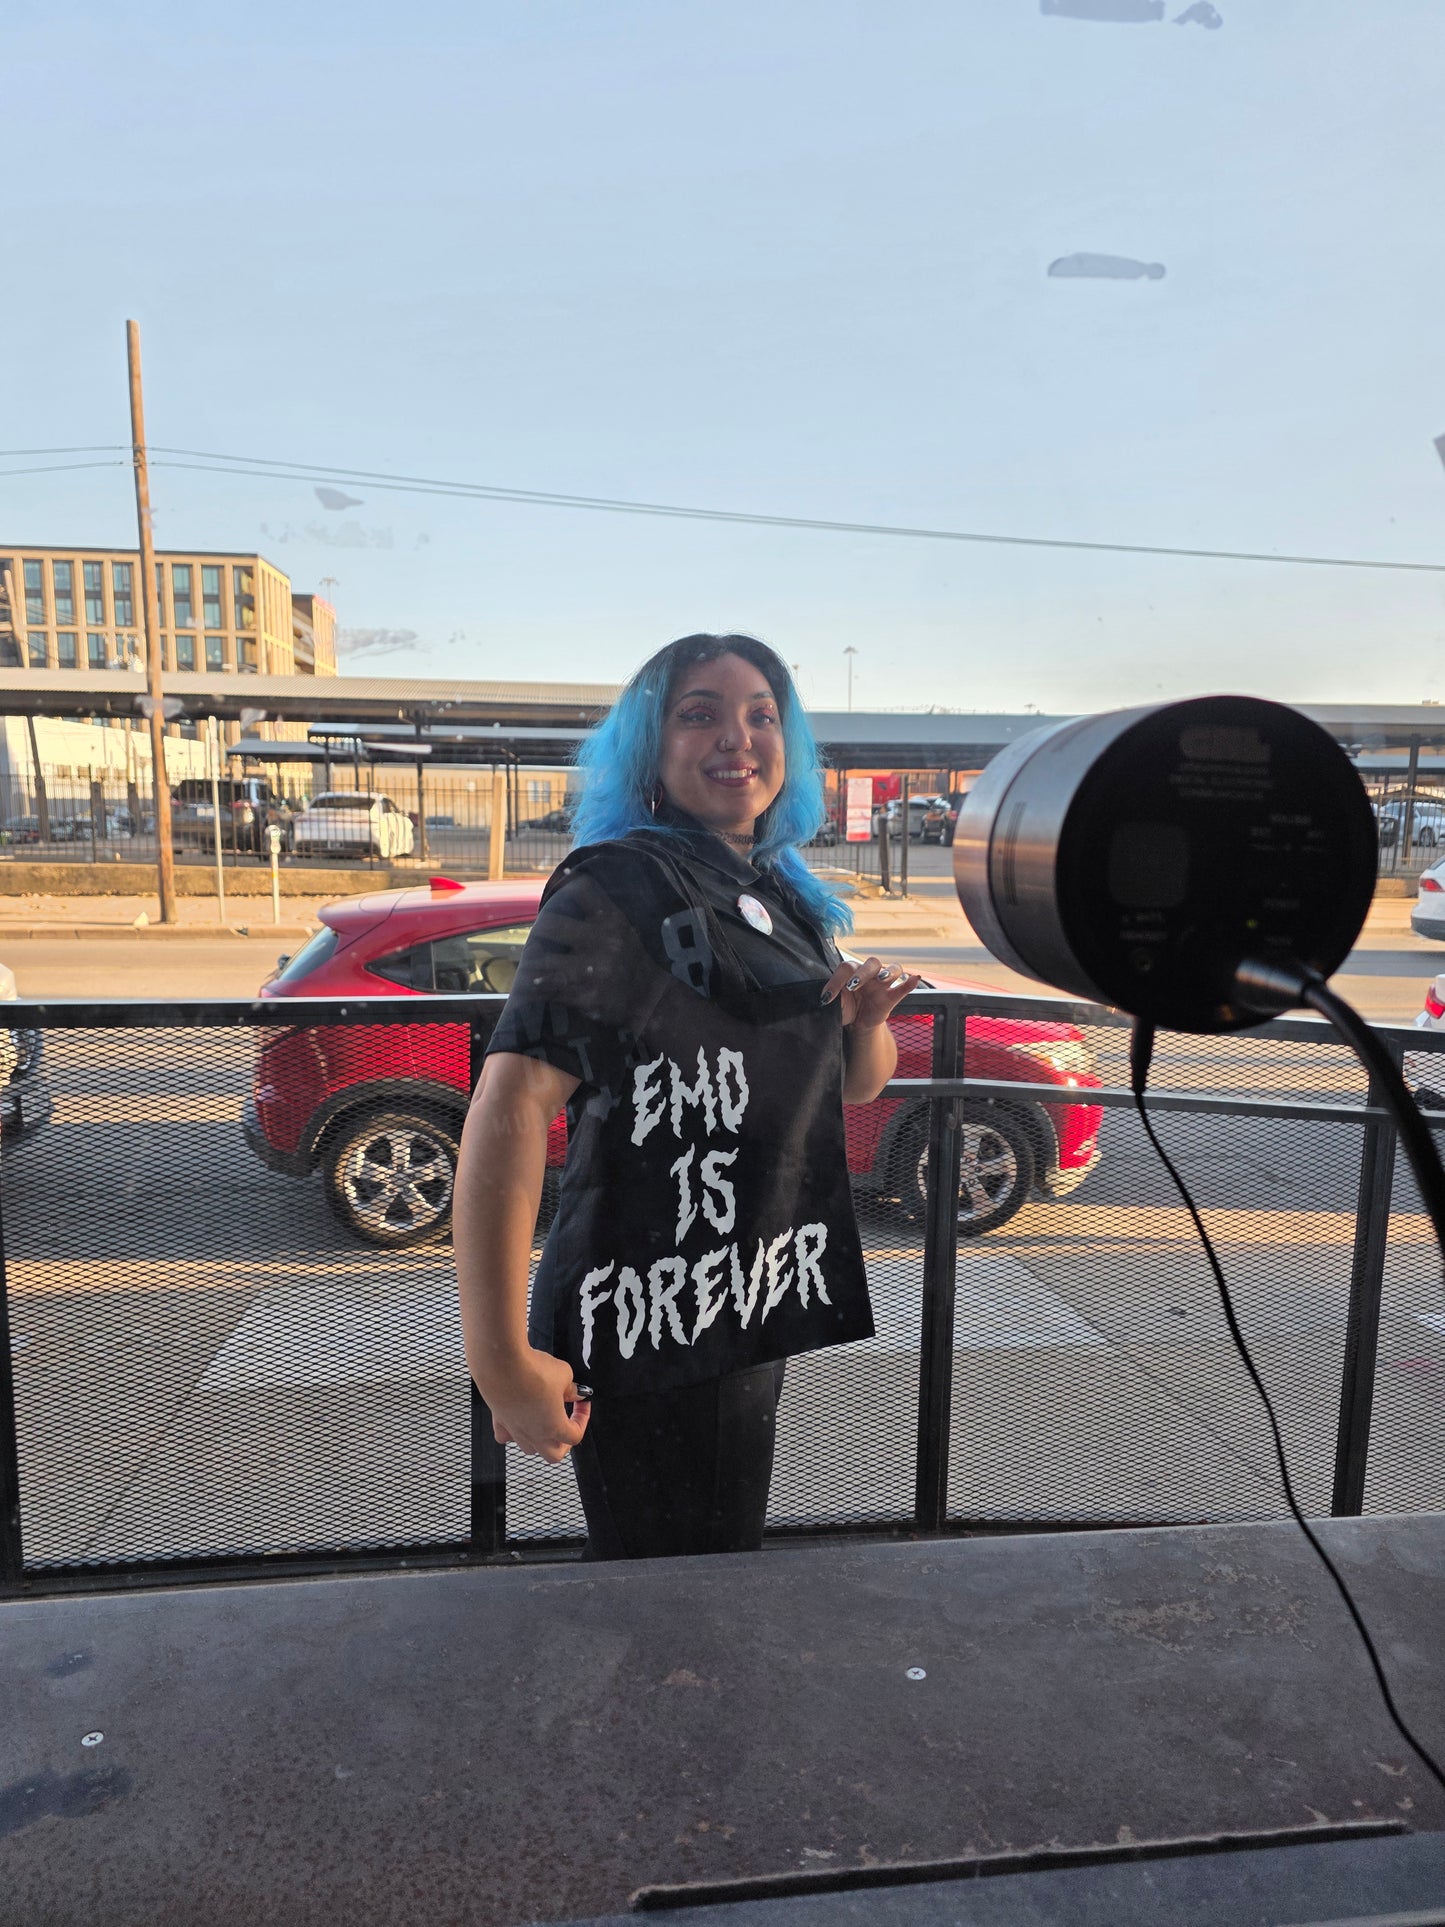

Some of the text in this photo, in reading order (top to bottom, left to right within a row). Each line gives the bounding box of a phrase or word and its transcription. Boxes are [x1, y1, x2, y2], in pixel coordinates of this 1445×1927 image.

[630, 1045, 750, 1147] EMO
[669, 1143, 739, 1247] IS
[579, 1222, 833, 1370] FOREVER
